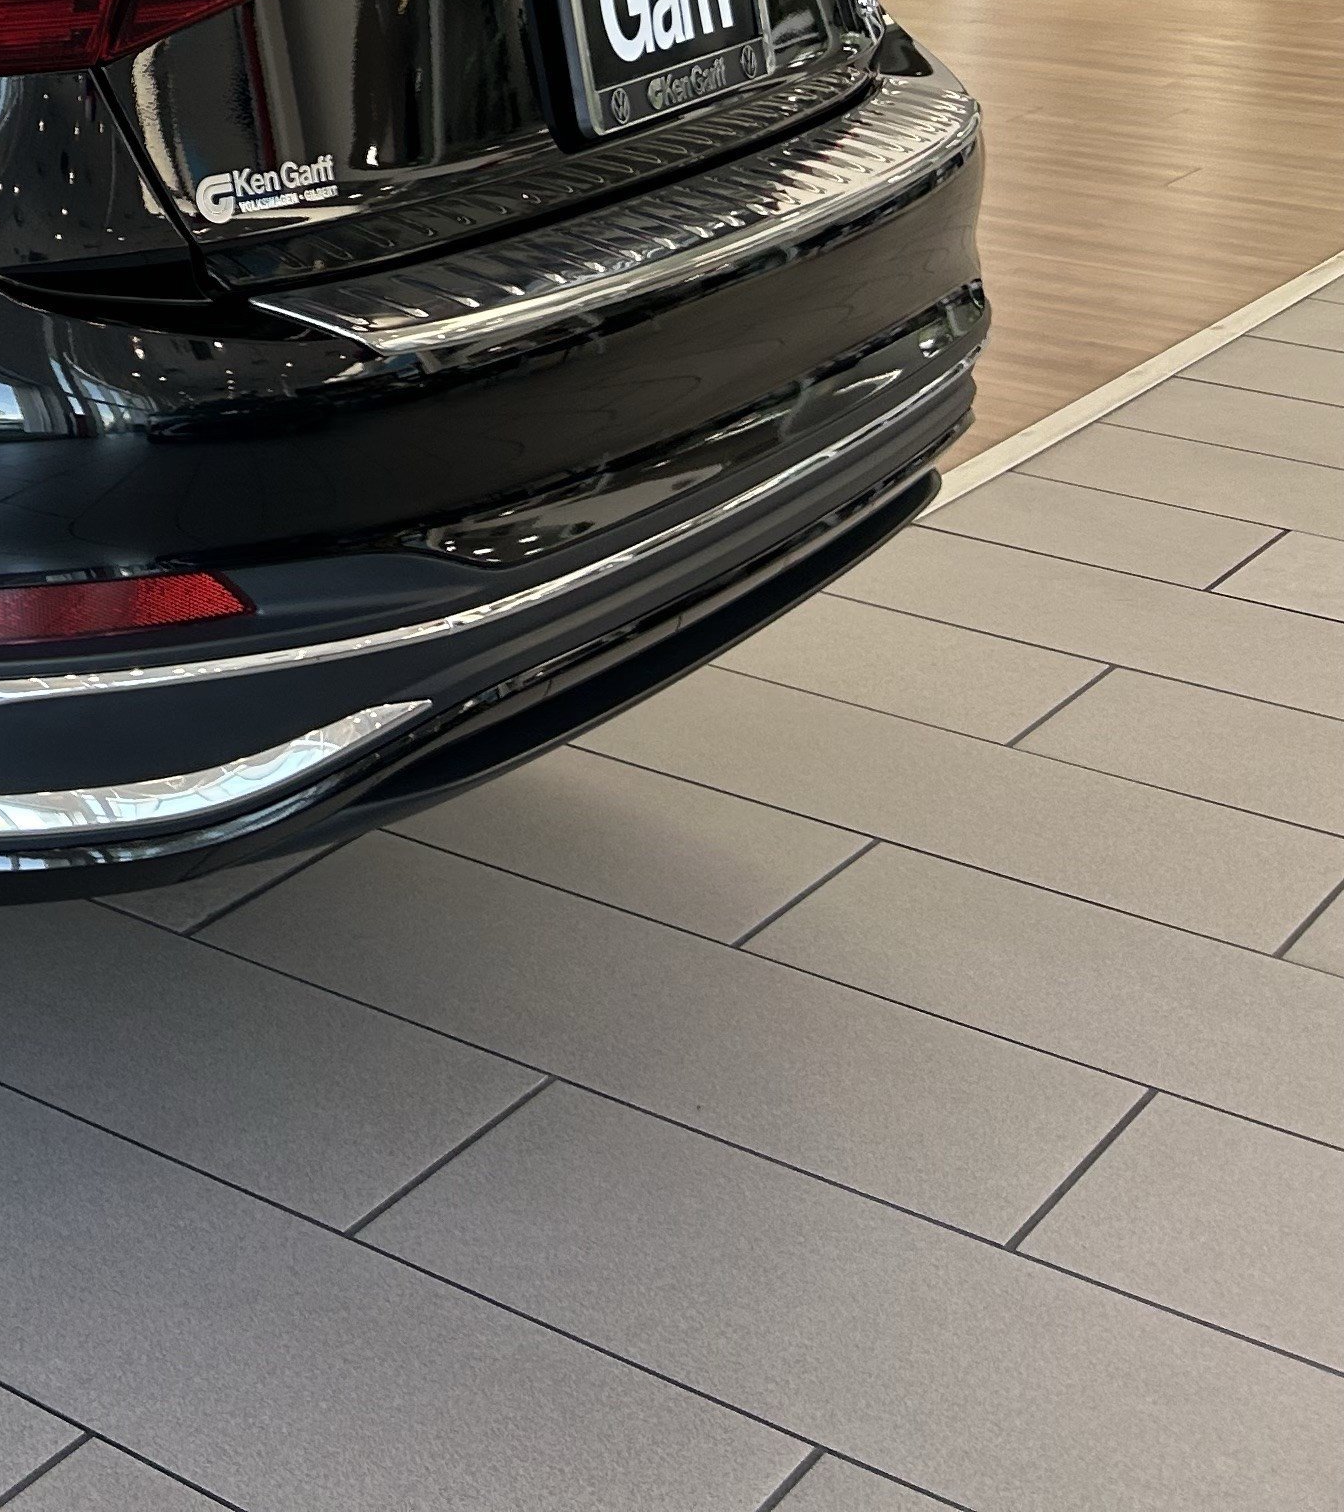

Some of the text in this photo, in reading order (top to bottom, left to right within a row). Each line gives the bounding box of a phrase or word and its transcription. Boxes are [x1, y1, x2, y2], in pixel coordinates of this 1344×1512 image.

[662, 74, 693, 106] Ken
[691, 57, 727, 94] Garff
[232, 168, 281, 197] Ken
[281, 155, 335, 188] Garff
